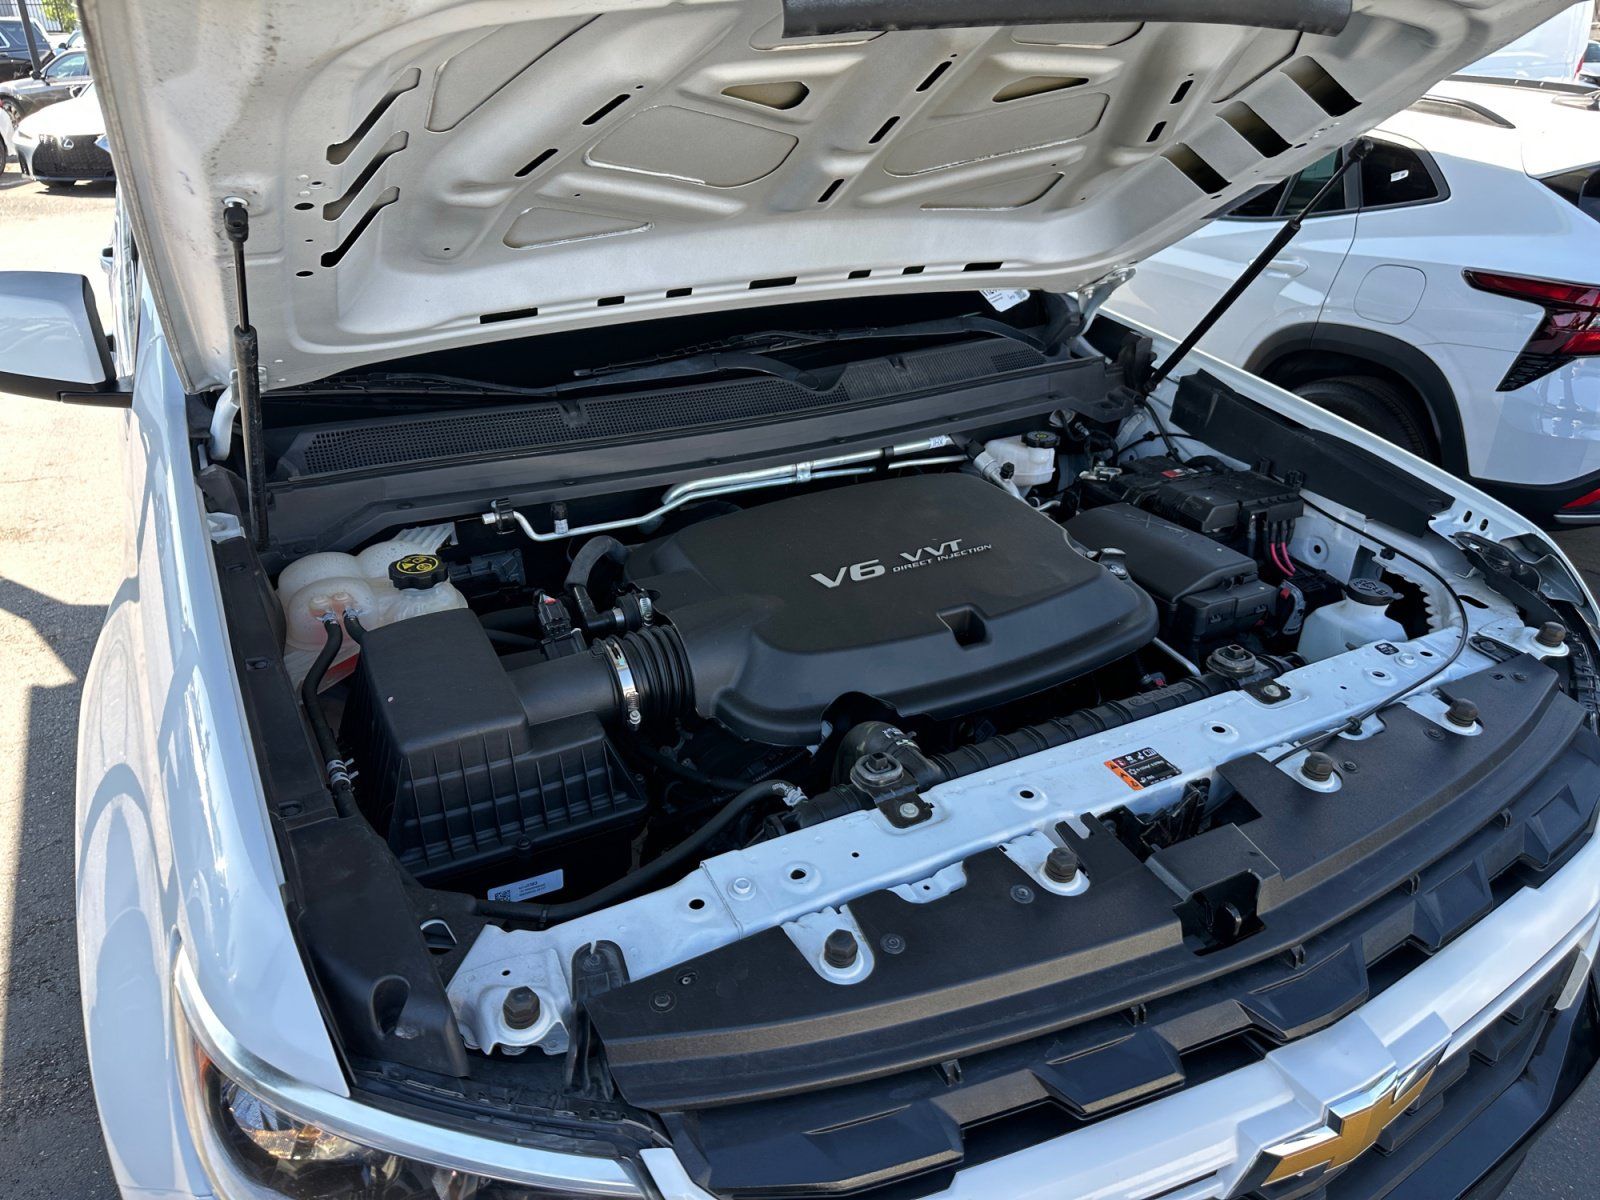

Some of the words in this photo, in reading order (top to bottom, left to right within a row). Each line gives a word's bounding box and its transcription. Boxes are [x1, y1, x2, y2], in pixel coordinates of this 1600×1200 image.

[810, 559, 886, 589] V6
[900, 538, 963, 562] VVT
[892, 558, 933, 573] DIRECT
[937, 543, 992, 562] INJECTION
